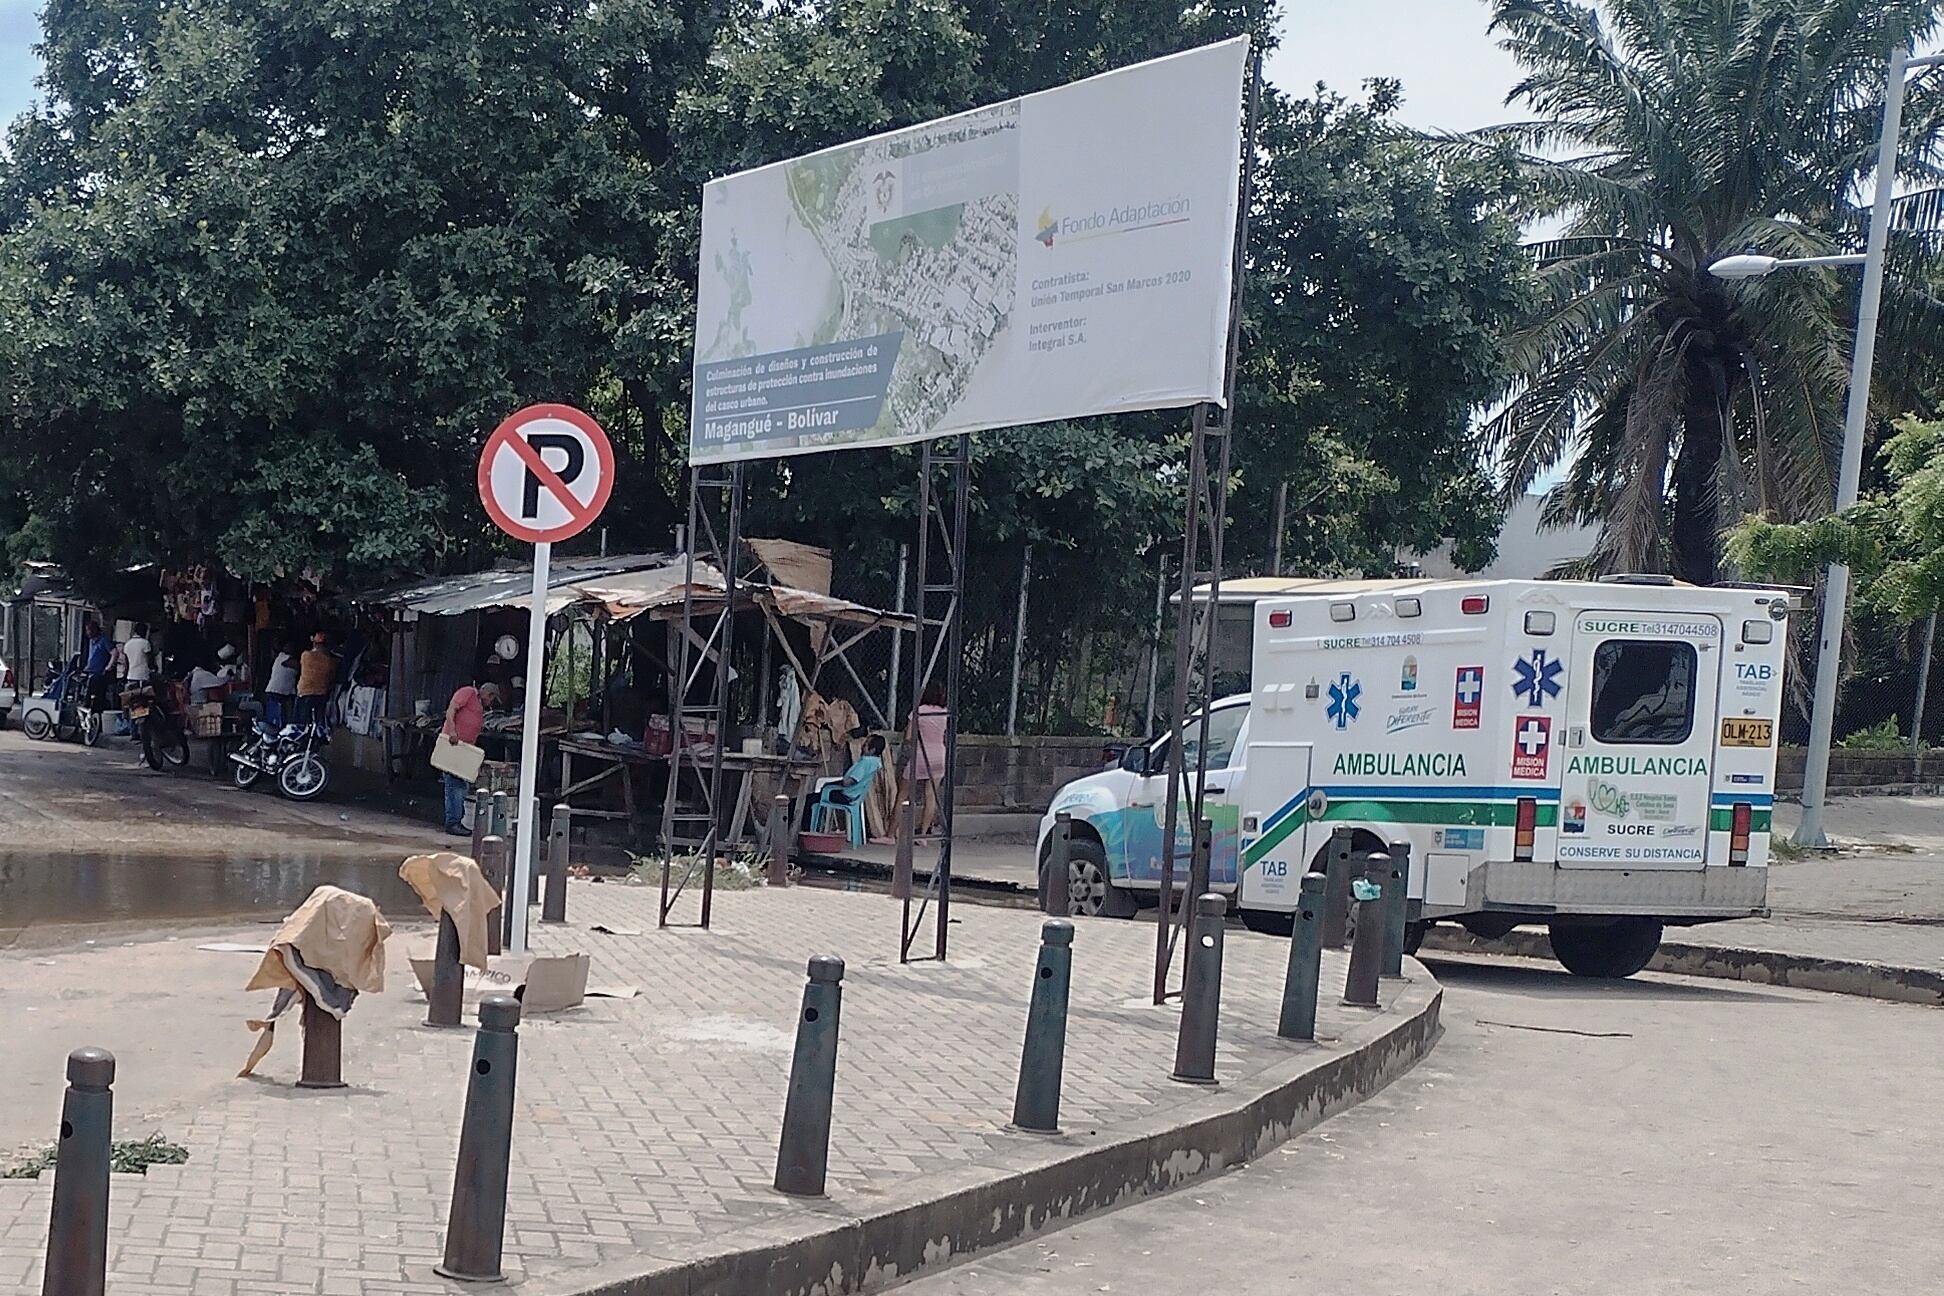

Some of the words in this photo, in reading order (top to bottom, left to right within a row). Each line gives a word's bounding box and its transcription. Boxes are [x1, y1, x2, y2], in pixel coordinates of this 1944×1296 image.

[1062, 211, 1105, 235] Fondo
[1108, 194, 1190, 226] Adaptación
[1031, 292, 1057, 308] Unión
[1060, 283, 1103, 303] Temporal
[1106, 281, 1124, 295] San
[1126, 275, 1162, 291] Marcos
[1165, 269, 1191, 285] 2020
[1032, 271, 1089, 291] Contratista:
[1029, 317, 1087, 335] Interventor:
[1028, 332, 1066, 352] Integral
[1067, 332, 1087, 346] S.A.
[706, 366, 752, 382] Culminación
[755, 363, 765, 375] de
[768, 357, 798, 373] diseños
[800, 358, 807, 371] y
[809, 347, 863, 367] construcción
[866, 344, 878, 357] de
[706, 382, 746, 398] estructuras
[747, 379, 757, 392] de
[758, 373, 797, 392] protección
[799, 368, 823, 384] contra
[825, 362, 877, 380] inundaciones
[705, 400, 717, 413] del
[717, 397, 739, 411] casco
[740, 396, 768, 410] urbano.
[704, 413, 772, 441] Magangué
[787, 407, 839, 430] Bolívar
[521, 433, 585, 519] P
[1584, 621, 1639, 633] SUCRE
[1323, 637, 1360, 649] SUCRE
[1372, 636, 1385, 648] 314
[1387, 635, 1400, 647] 704
[1734, 663, 1772, 680] TAB
[1333, 753, 1467, 776] AMBULANCIA
[1513, 766, 1544, 777] MEDICA
[1516, 757, 1544, 767] MISION
[1567, 756, 1708, 776] AMBULANCIA
[1607, 824, 1655, 836] SUCRE
[1559, 846, 1620, 858] CONSERVE
[1625, 848, 1640, 859] SU
[1643, 848, 1701, 859] DISTANCIA
[1260, 860, 1288, 876] TAB
